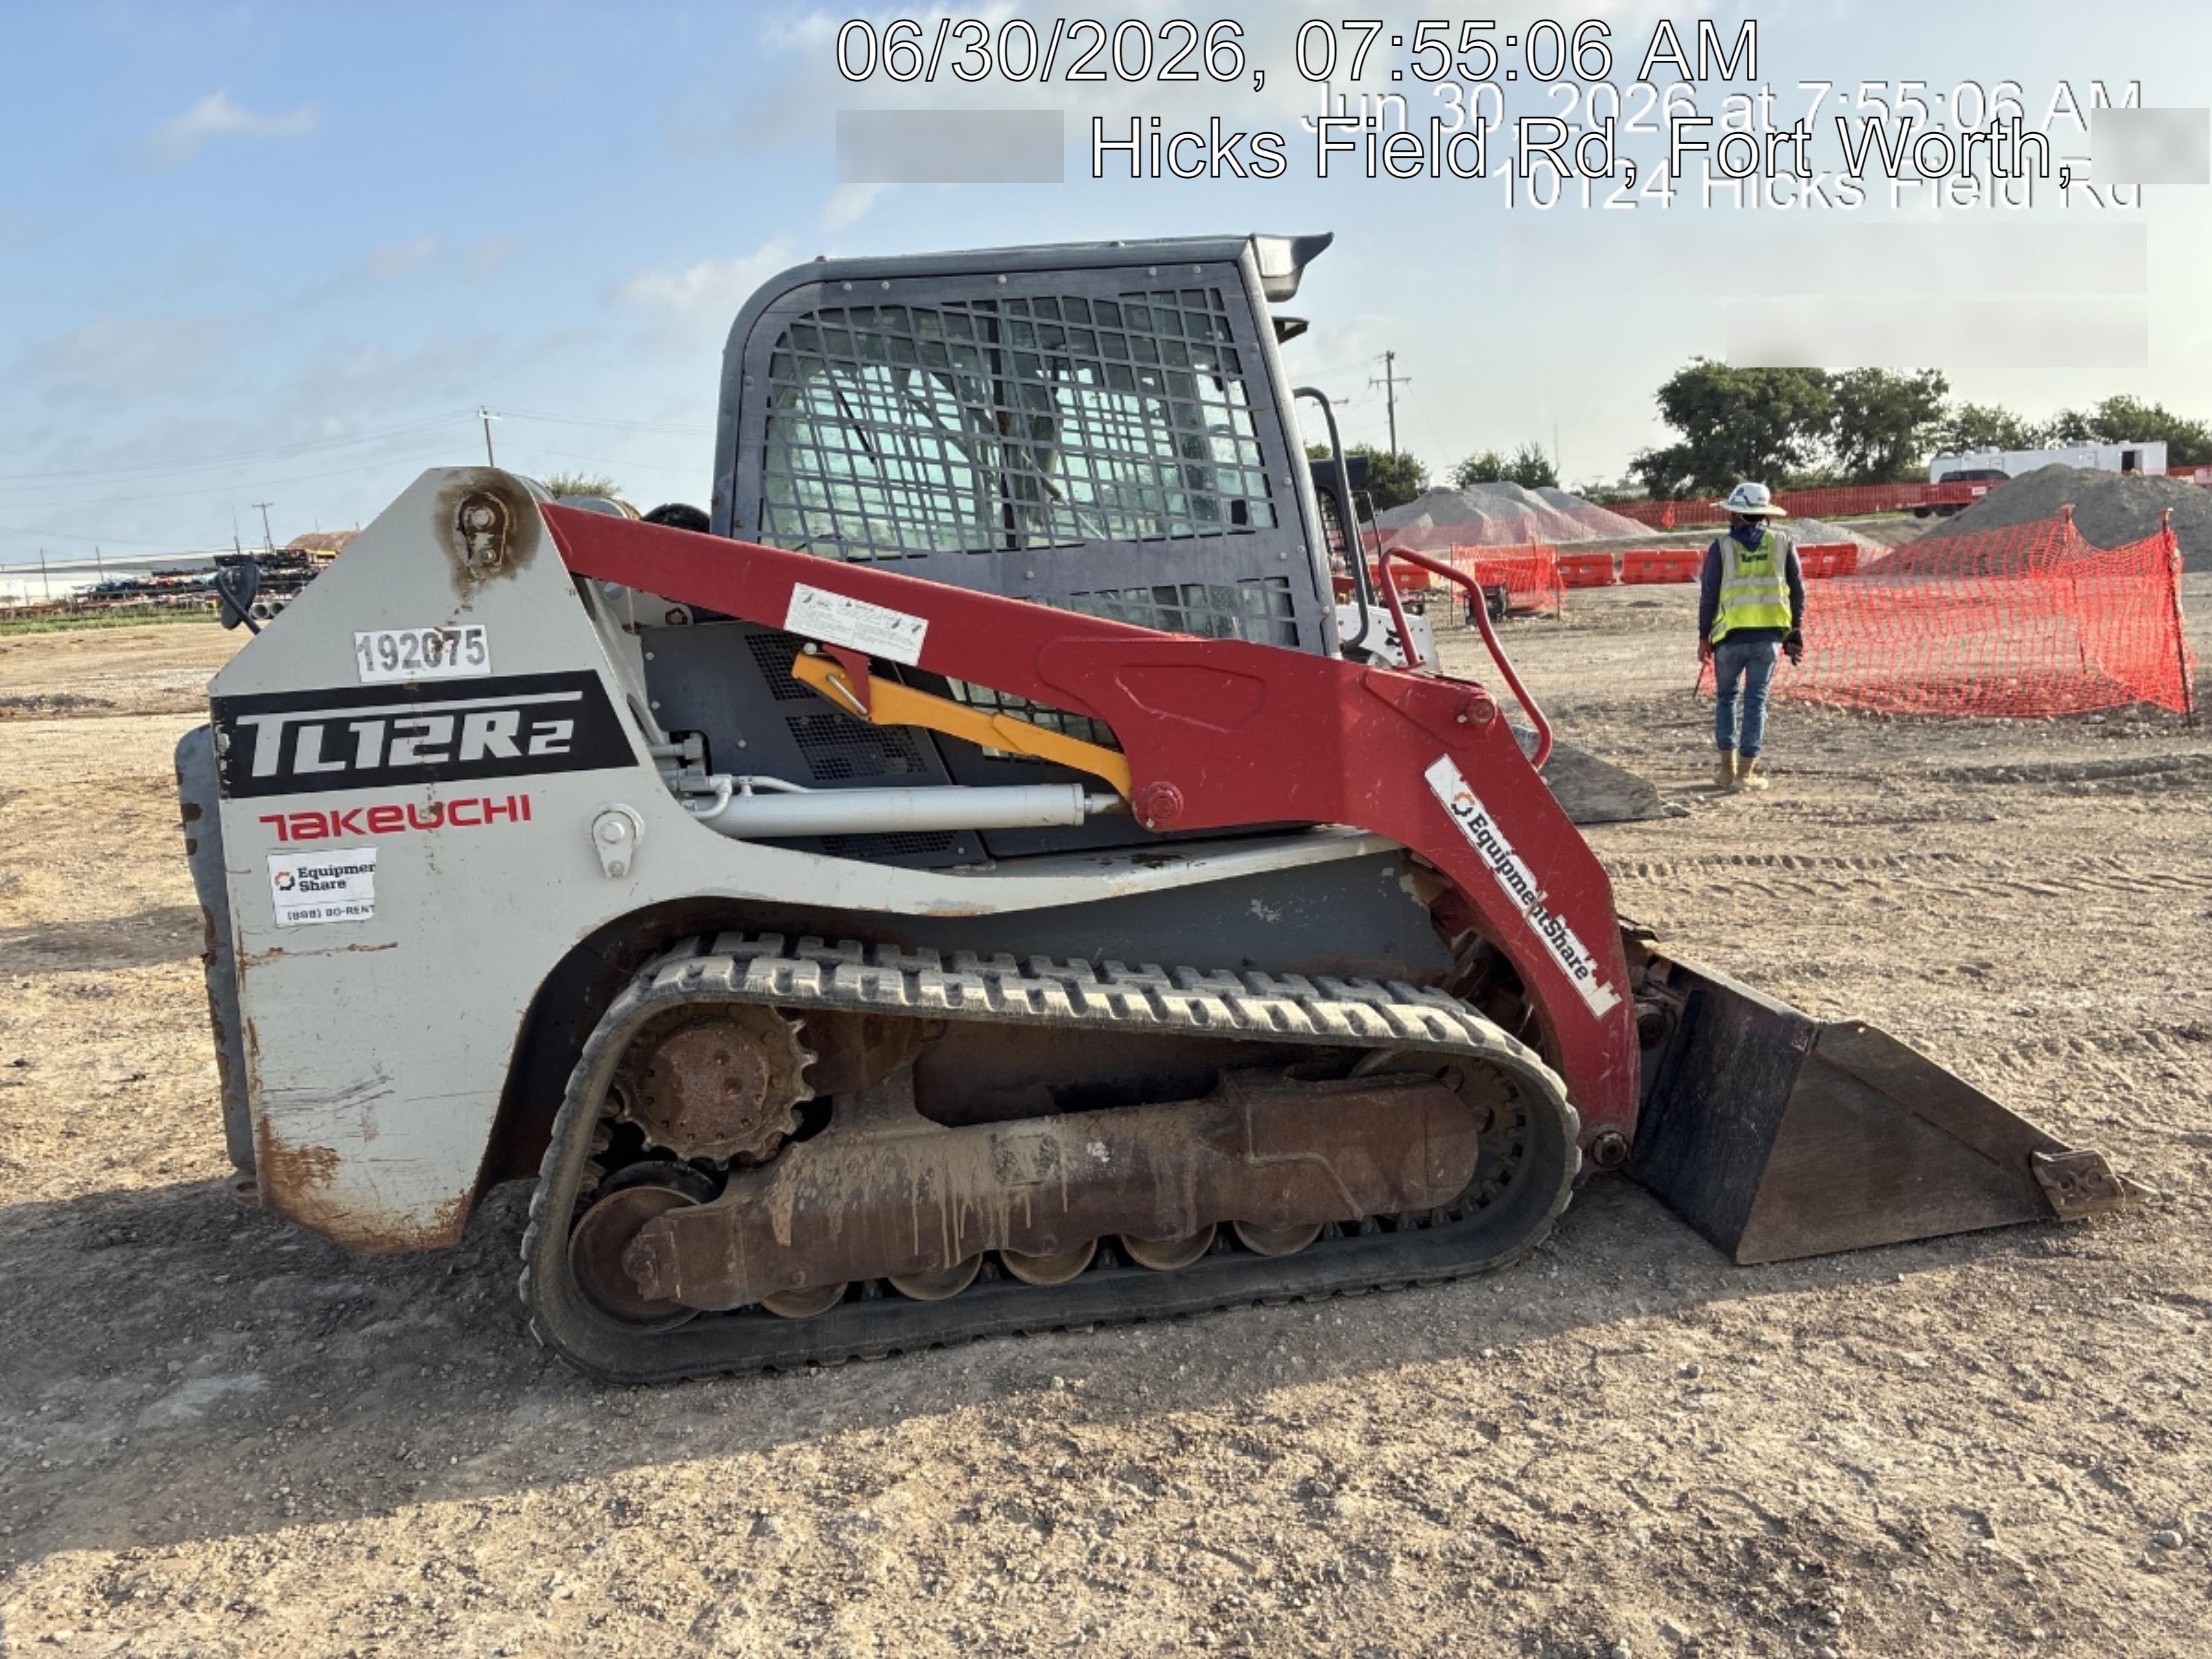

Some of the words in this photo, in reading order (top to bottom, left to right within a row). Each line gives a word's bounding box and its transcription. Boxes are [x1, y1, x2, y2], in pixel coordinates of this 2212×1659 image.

[354, 628, 487, 672] 192075
[235, 691, 584, 778] TL12R2
[298, 879, 347, 892] Share
